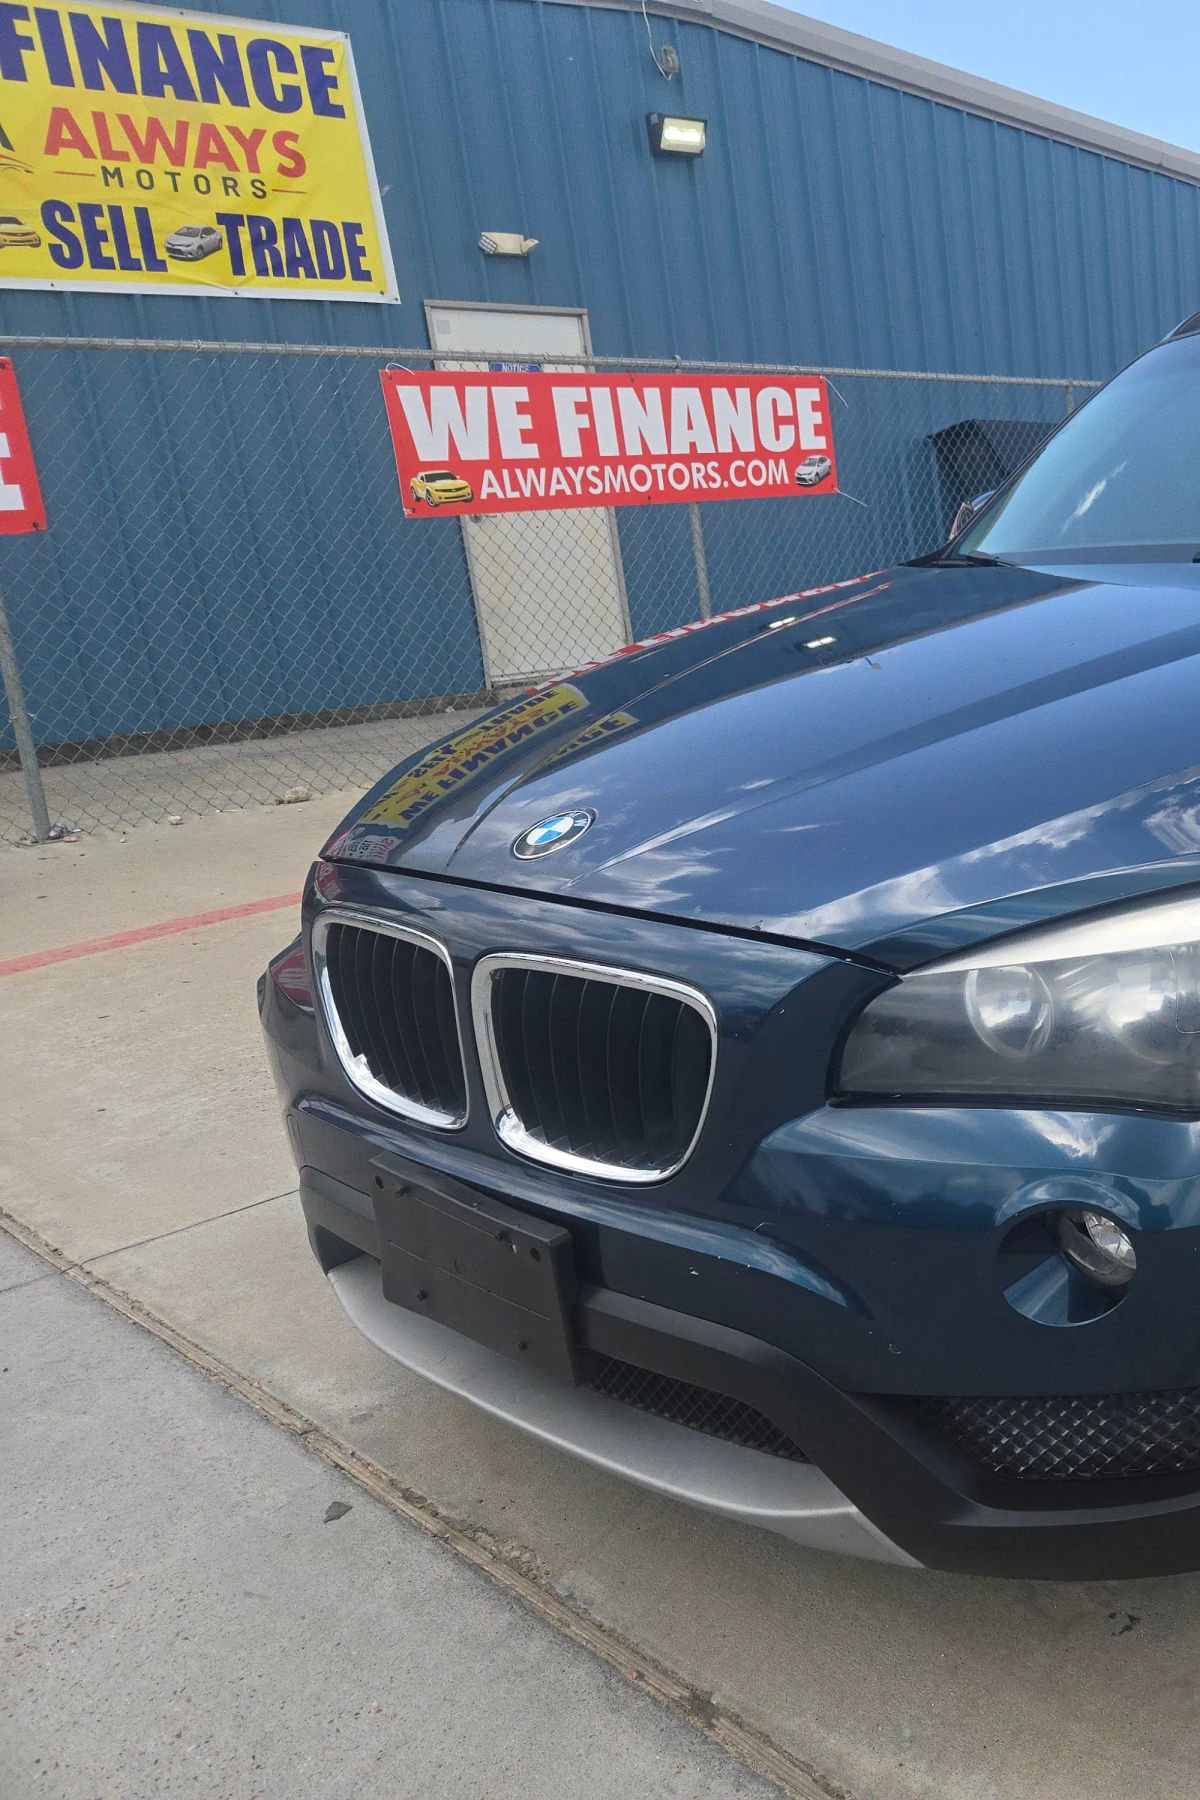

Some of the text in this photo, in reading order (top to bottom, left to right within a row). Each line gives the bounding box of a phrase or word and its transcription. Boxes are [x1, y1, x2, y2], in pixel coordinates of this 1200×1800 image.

[0, 3, 346, 119] FINANCE
[43, 106, 307, 178] ALWAYS
[101, 165, 267, 200] MOTORS
[40, 199, 373, 282] SELL TRADE
[396, 385, 827, 462] WE FINANCE
[480, 458, 790, 500] ALWAYSMOTORS.COM
